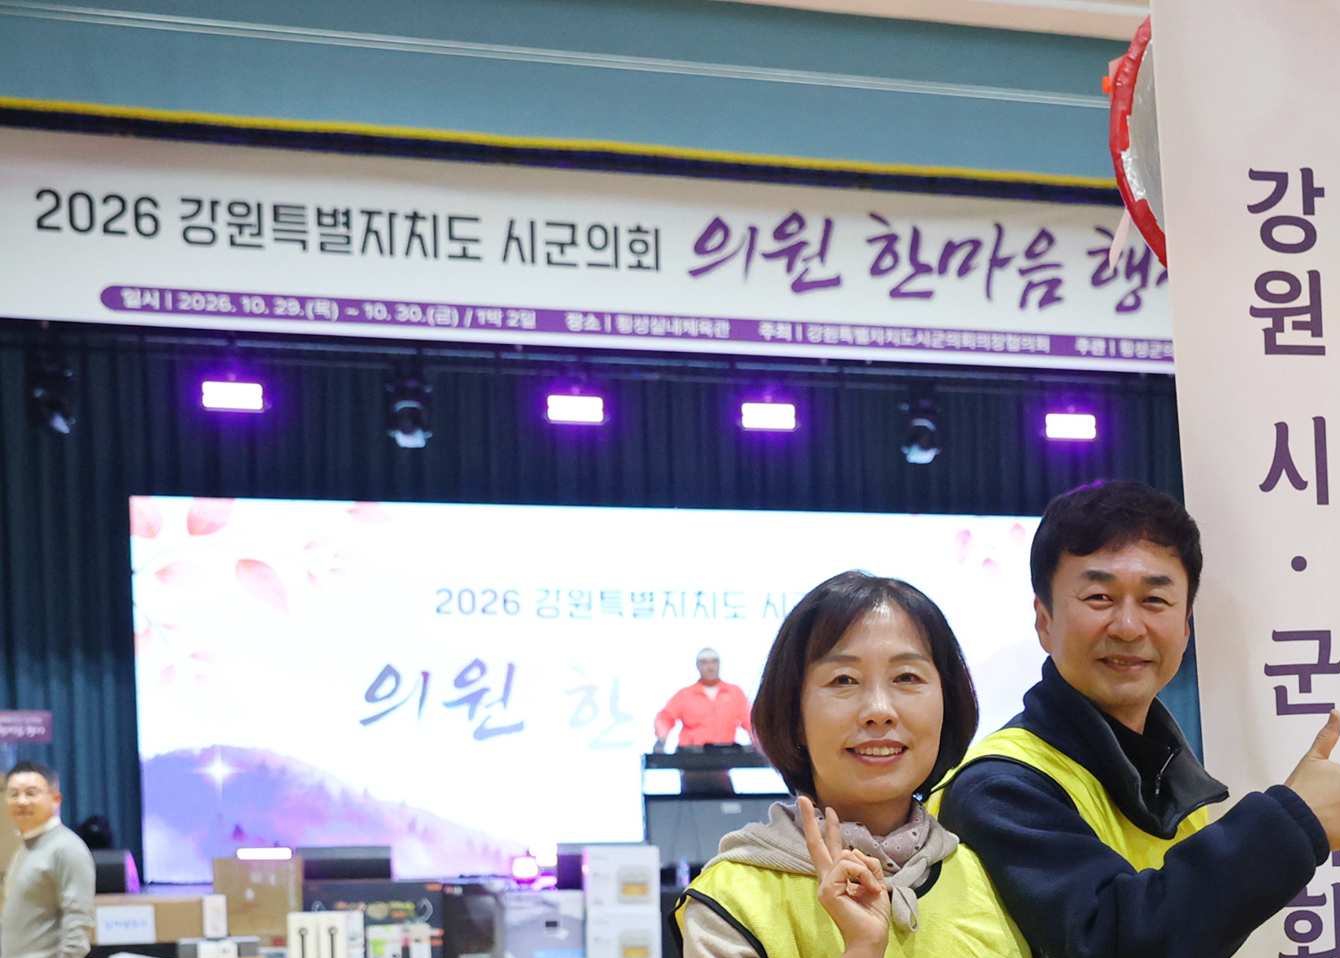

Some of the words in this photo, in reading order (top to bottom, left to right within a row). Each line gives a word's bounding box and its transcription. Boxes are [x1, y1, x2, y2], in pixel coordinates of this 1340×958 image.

[35, 188, 161, 238] 2026
[179, 196, 482, 262] 강원특별자치도
[502, 217, 661, 273] 시군의회
[687, 210, 842, 294] 의원
[866, 211, 1065, 311] 한마음
[1086, 225, 1168, 313] 행
[1246, 167, 1327, 357] 강원
[121, 287, 161, 310] 일시
[177, 293, 236, 313] 2026.
[241, 295, 270, 315] 10.
[362, 302, 392, 321] 10.
[476, 308, 503, 328] 1박
[506, 309, 537, 329] 2일
[435, 588, 522, 615] 2026
[535, 588, 747, 620] 강원특별자치도
[358, 656, 526, 742] 의원
